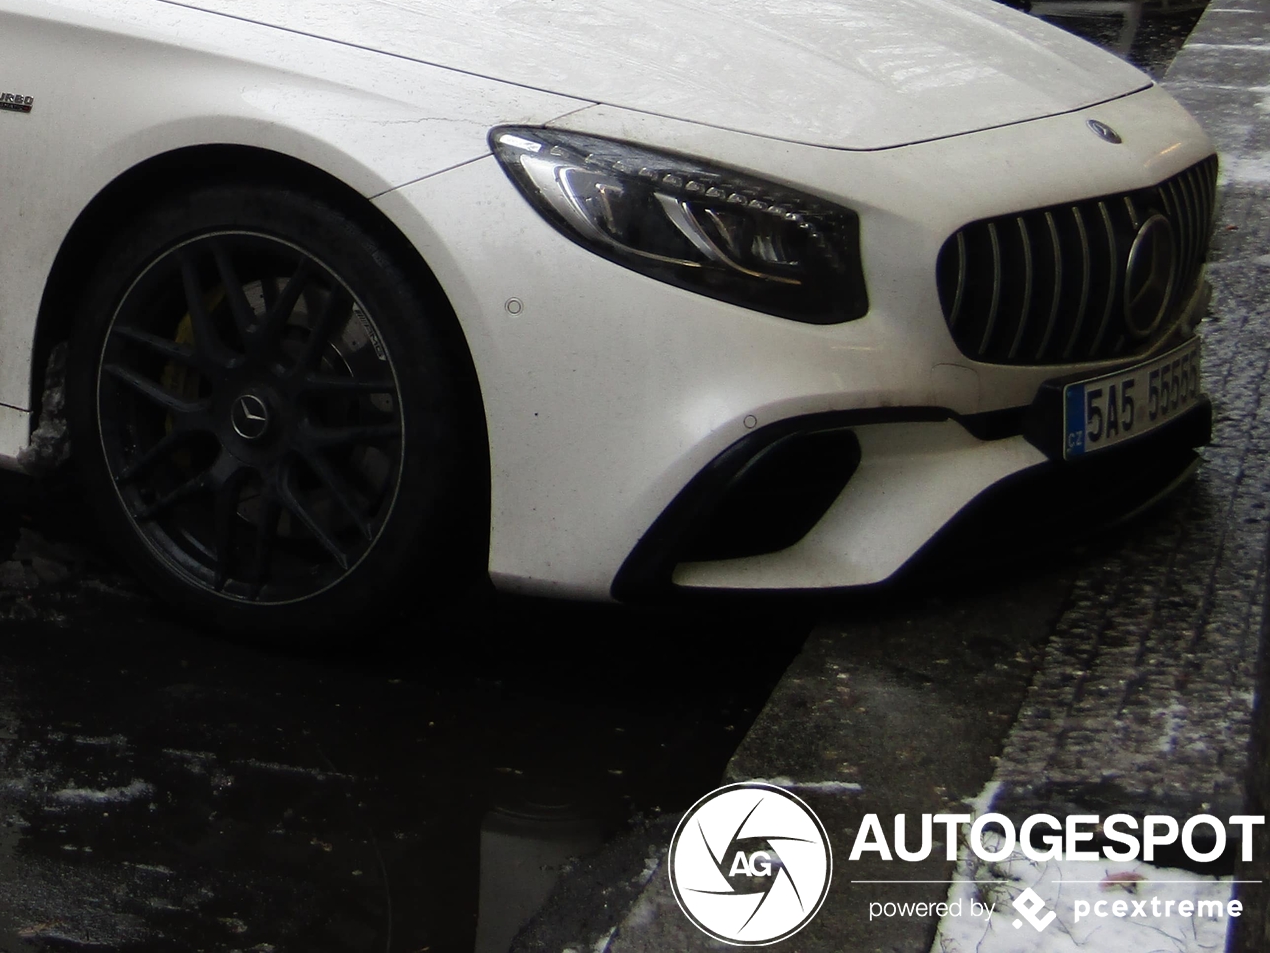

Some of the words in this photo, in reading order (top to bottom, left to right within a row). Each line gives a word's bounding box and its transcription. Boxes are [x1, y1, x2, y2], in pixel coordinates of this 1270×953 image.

[1068, 430, 1084, 448] CZ
[1086, 378, 1135, 442] 5A5
[1148, 348, 1198, 422] 55555
